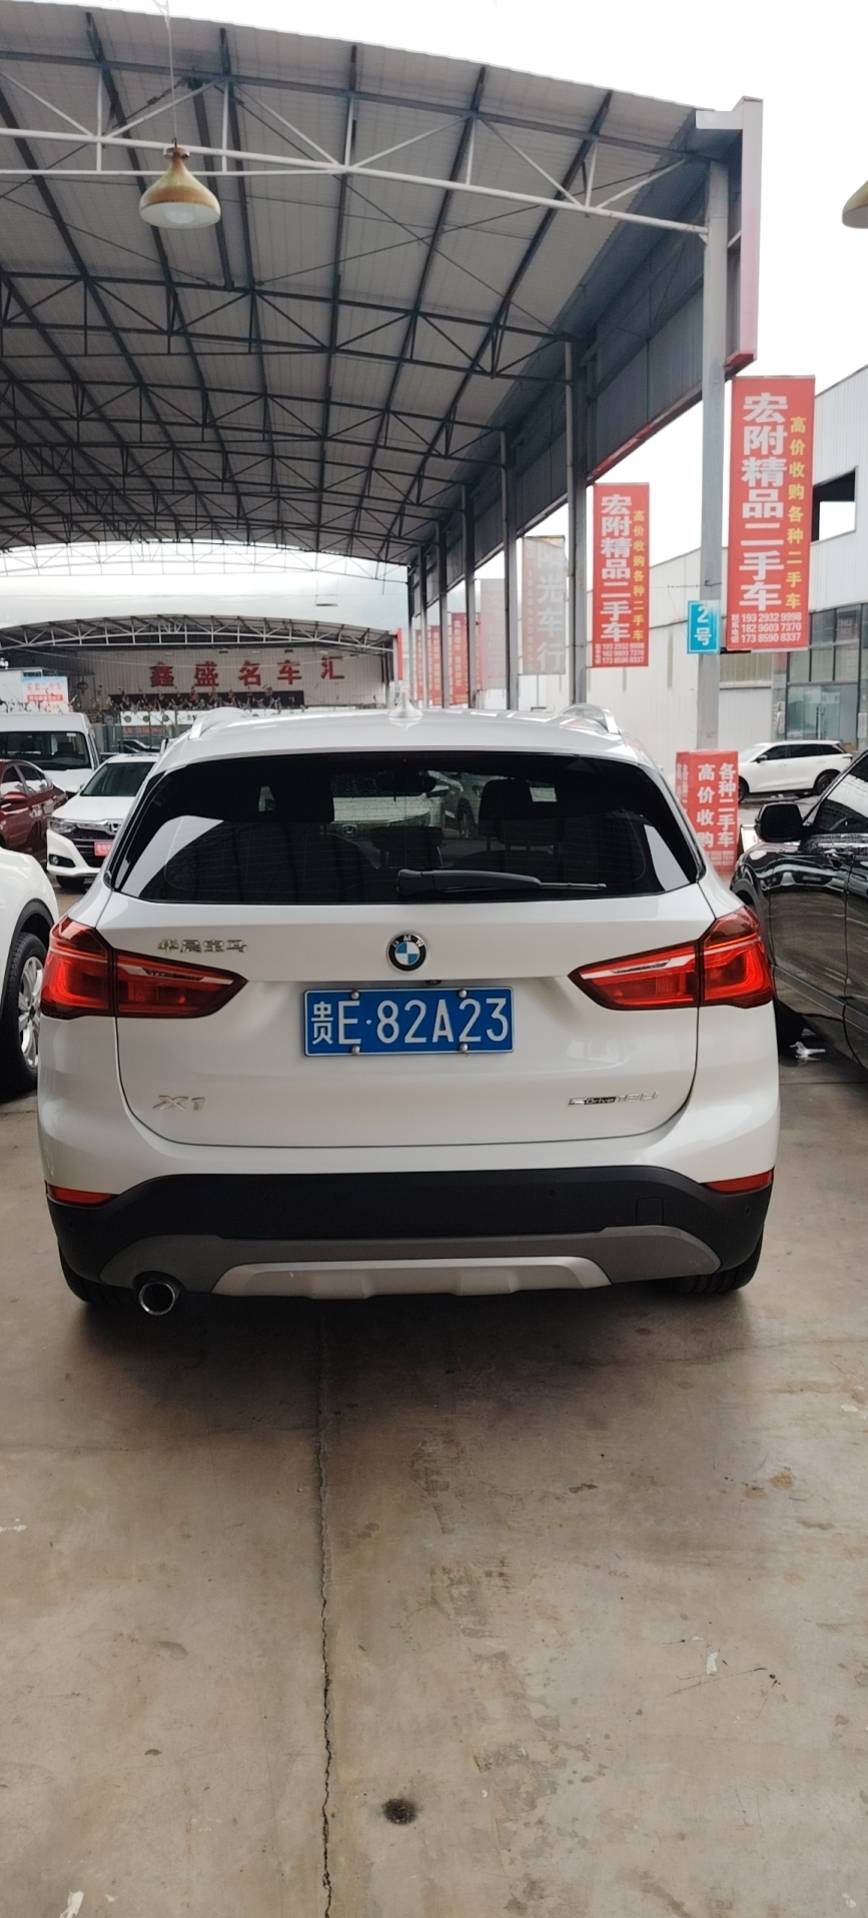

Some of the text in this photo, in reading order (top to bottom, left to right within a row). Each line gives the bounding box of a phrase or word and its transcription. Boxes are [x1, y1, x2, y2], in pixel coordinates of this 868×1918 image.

[739, 392, 788, 611] 宏附精品二手车
[785, 416, 806, 609] 高价收购各种二手车
[600, 494, 632, 642] 宏附精品二手车
[632, 510, 645, 641] 高价收购各种二手车
[693, 604, 712, 646] 2号
[741, 633, 757, 643] 173
[150, 655, 345, 688] 鑫盛名车汇
[696, 763, 715, 849] 高价收购
[717, 763, 736, 848] 各种二手车
[310, 997, 510, 1046] 贵E·82A23
[151, 1094, 206, 1111] X1
